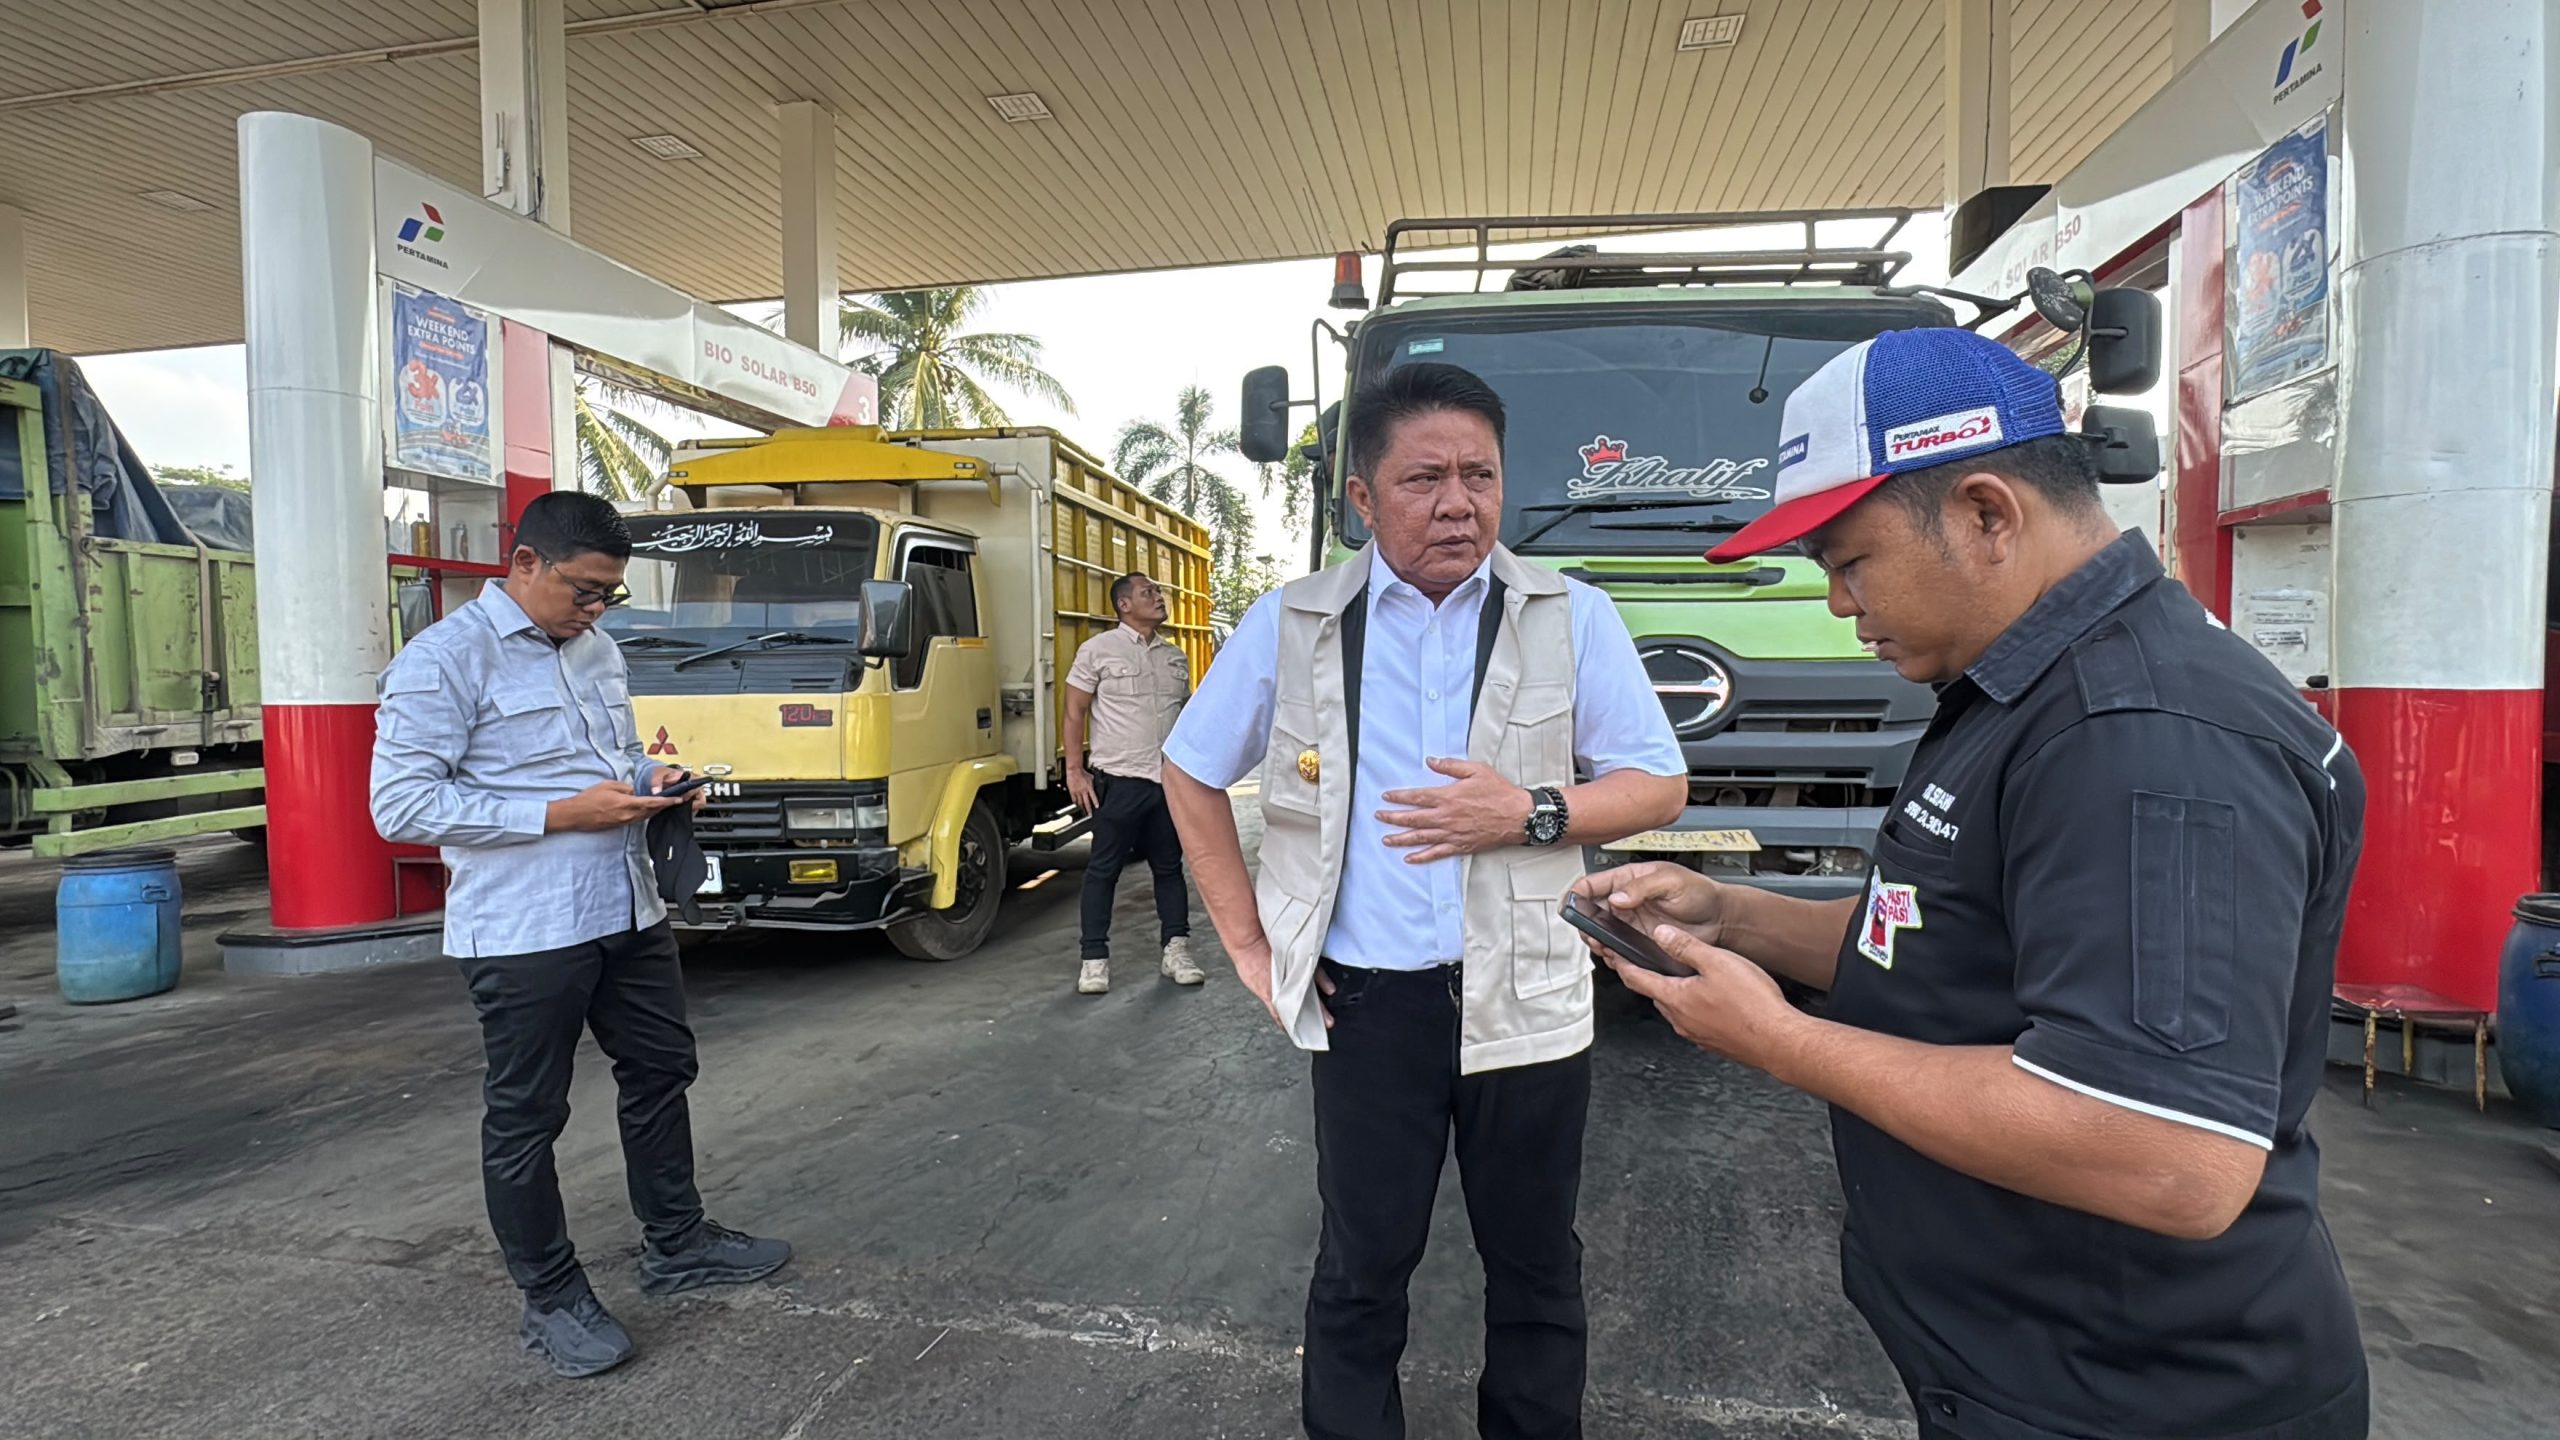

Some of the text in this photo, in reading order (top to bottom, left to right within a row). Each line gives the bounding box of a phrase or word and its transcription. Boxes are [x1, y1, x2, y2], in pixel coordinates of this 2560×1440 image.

[2273, 63, 2322, 105] PERTAMINA
[2248, 196, 2275, 225] EXTRA
[2276, 175, 2314, 209] POINTS
[2255, 164, 2305, 208] WEEKEND
[2055, 214, 2081, 252] B50
[397, 243, 449, 270] PERTAMINA
[407, 324, 440, 344] EXTRA
[442, 337, 476, 355] POINTS
[415, 314, 469, 341] WEEKEND
[704, 340, 817, 397] BIO SOLAR B50
[1890, 427, 1977, 455] TURBO
[1893, 426, 1940, 442] PERTAMAX
[1567, 455, 1770, 499] Khalif
[1887, 889, 1910, 908] PASTI
